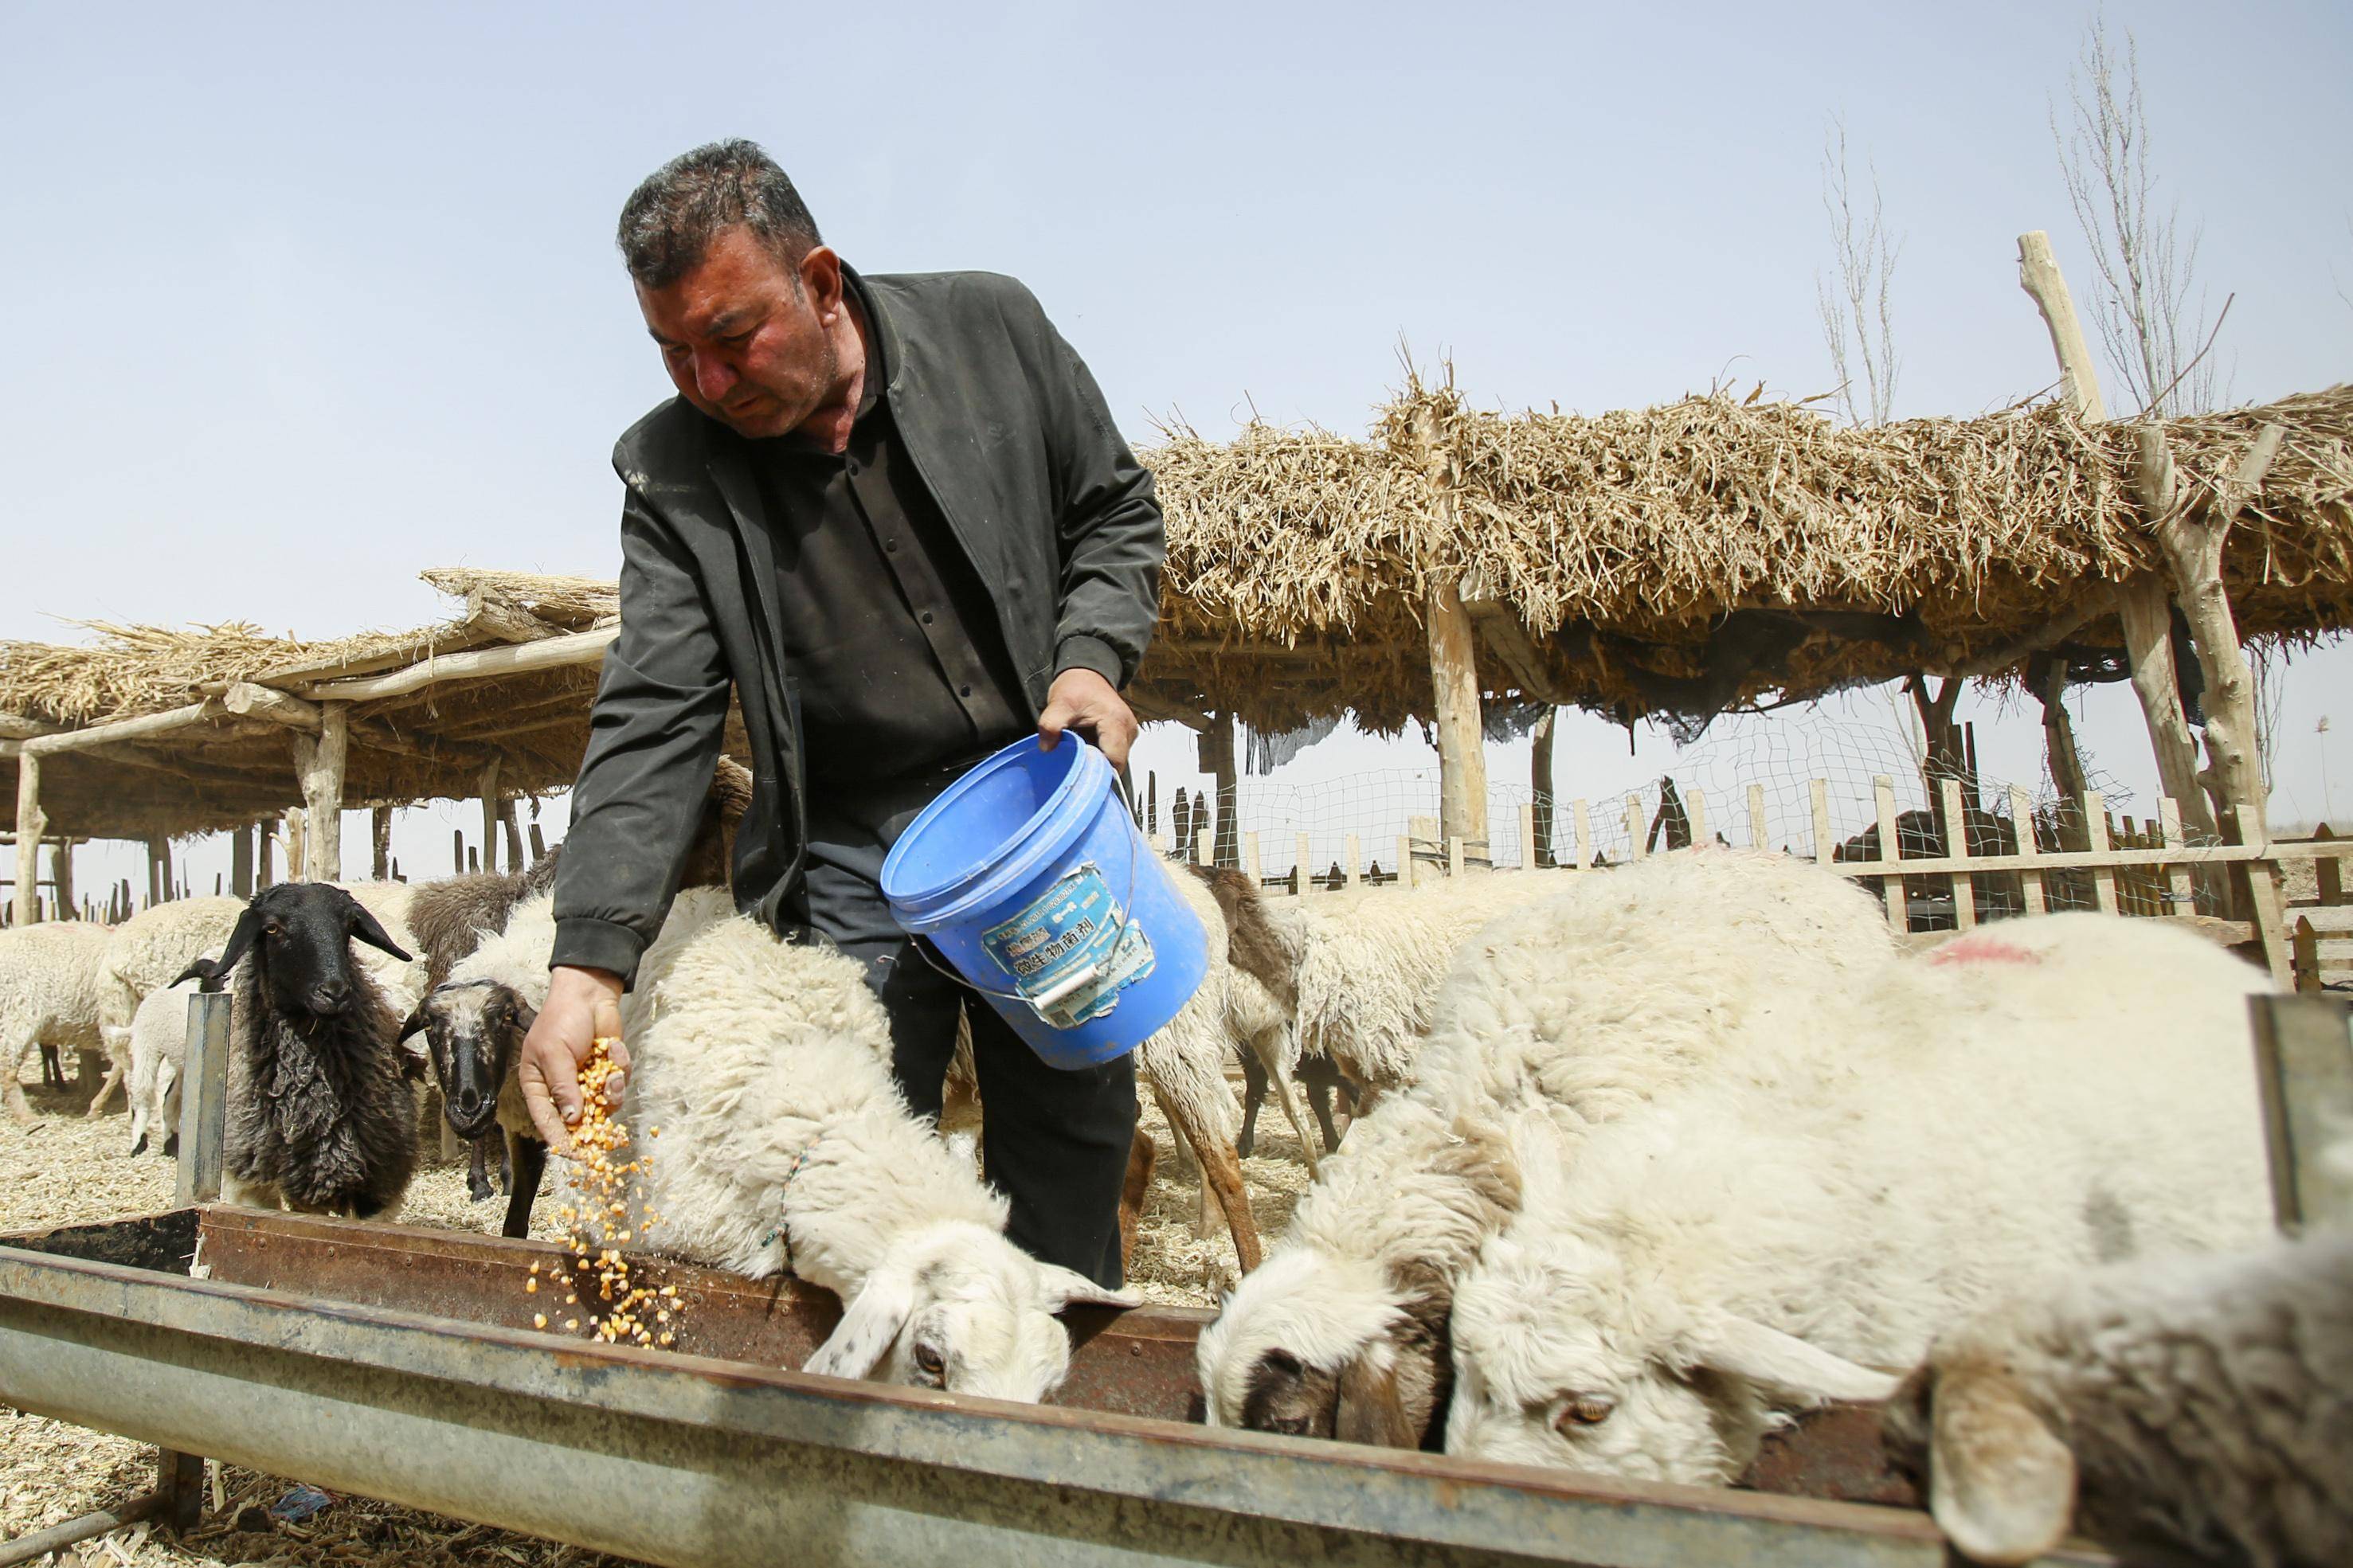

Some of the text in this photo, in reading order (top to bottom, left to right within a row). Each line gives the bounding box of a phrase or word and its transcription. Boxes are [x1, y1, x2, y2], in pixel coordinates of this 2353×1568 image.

[1015, 917, 1095, 976] 微生物菌剂
